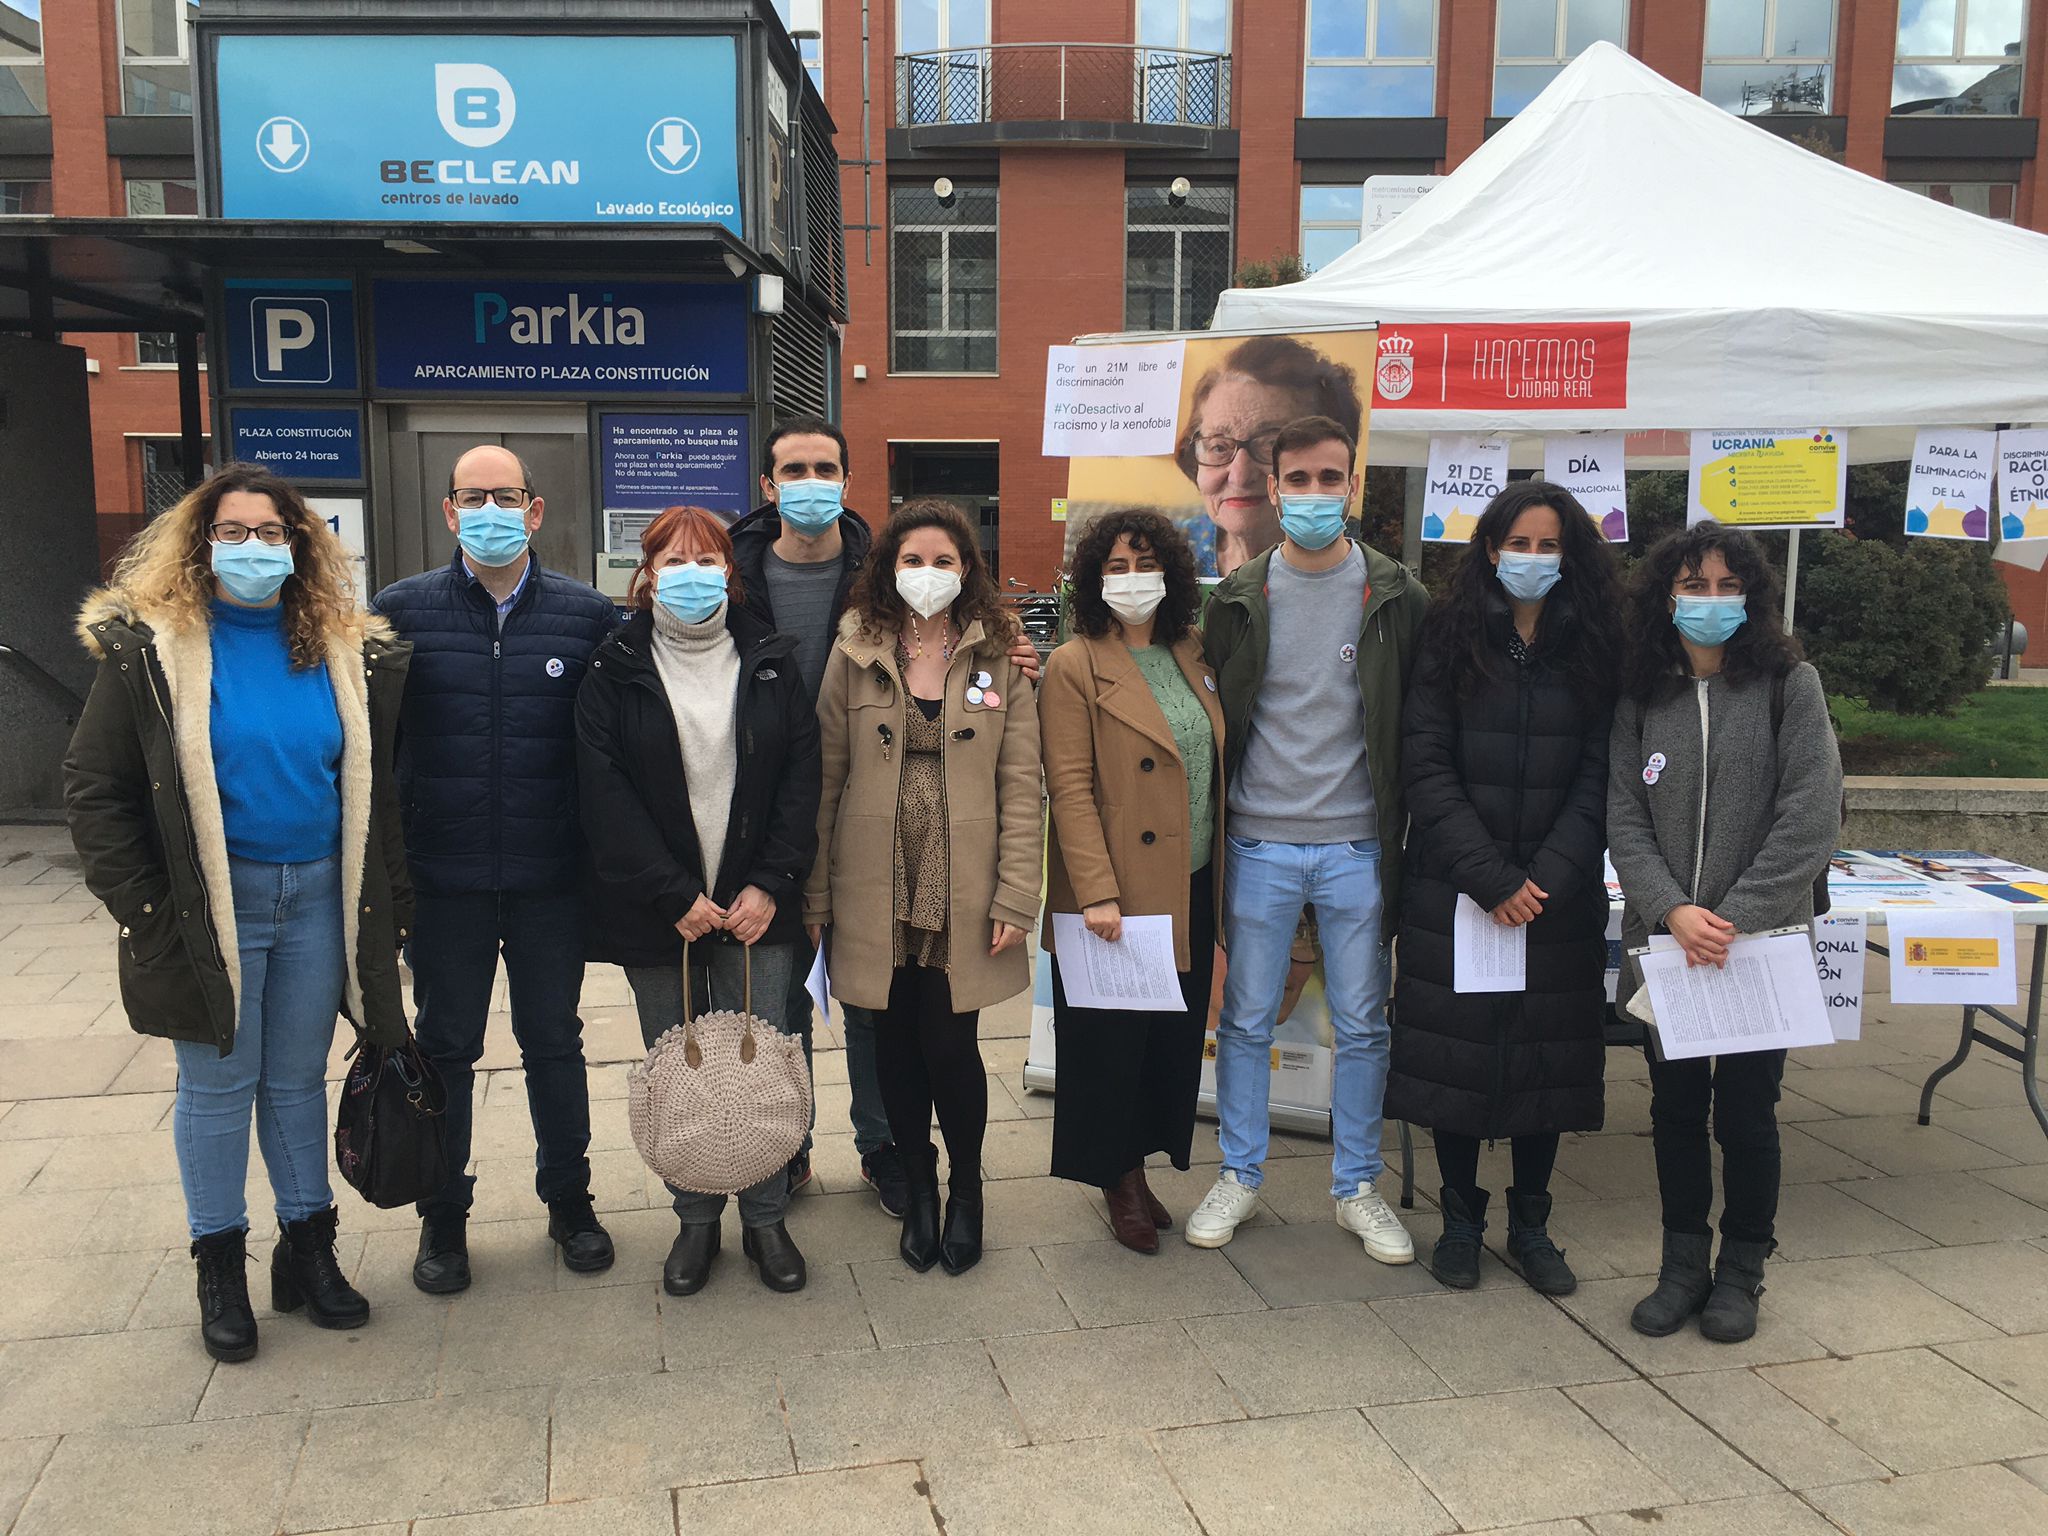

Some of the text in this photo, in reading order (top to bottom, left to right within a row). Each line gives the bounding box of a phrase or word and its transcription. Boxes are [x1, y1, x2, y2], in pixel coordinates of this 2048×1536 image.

[453, 87, 501, 128] B
[380, 160, 580, 185] BECLEAN
[381, 191, 520, 207] centros de lavado
[596, 201, 734, 220] Lavado Ecológico
[474, 292, 645, 346] Parkia
[266, 308, 315, 372] P
[1057, 360, 1176, 373] Por un 21M libre de
[1472, 338, 1596, 383] HACEMOS
[414, 363, 710, 381] APARCAMIENTO PLAZA CONSTITUCIÓN
[1056, 376, 1124, 387] discriminación
[1563, 380, 1594, 398] REAL
[1054, 402, 1144, 414] #YoDesactivo al
[612, 427, 624, 435] Ha
[630, 427, 678, 435] encontrado
[700, 427, 722, 437] plaza
[727, 427, 738, 436] de
[1053, 416, 1171, 432] racismo y la xenofobia
[239, 427, 352, 438] PLAZA CONSTITUCIÓN
[613, 437, 672, 446] aparcamiento,
[687, 437, 718, 446] busque
[720, 438, 738, 446] más
[1711, 438, 1776, 451] UCRANIA
[255, 450, 339, 460] Abierto 24 horas
[614, 452, 635, 460] Ahora
[656, 451, 682, 460] Parkia
[688, 453, 709, 461] puede
[711, 453, 736, 462] adquirir
[1928, 445, 1978, 460] PARA LA
[629, 461, 647, 469] plaza
[1568, 454, 1601, 474] DÍA
[1915, 464, 1987, 480] ELIMINACIÓN
[2009, 458, 2048, 474] RACI
[1447, 463, 1494, 482] 21 DE
[2032, 473, 2045, 487] O
[1430, 479, 1501, 499] MARZO
[1932, 486, 1966, 499] DE LA
[1815, 940, 1859, 953] ONAL
